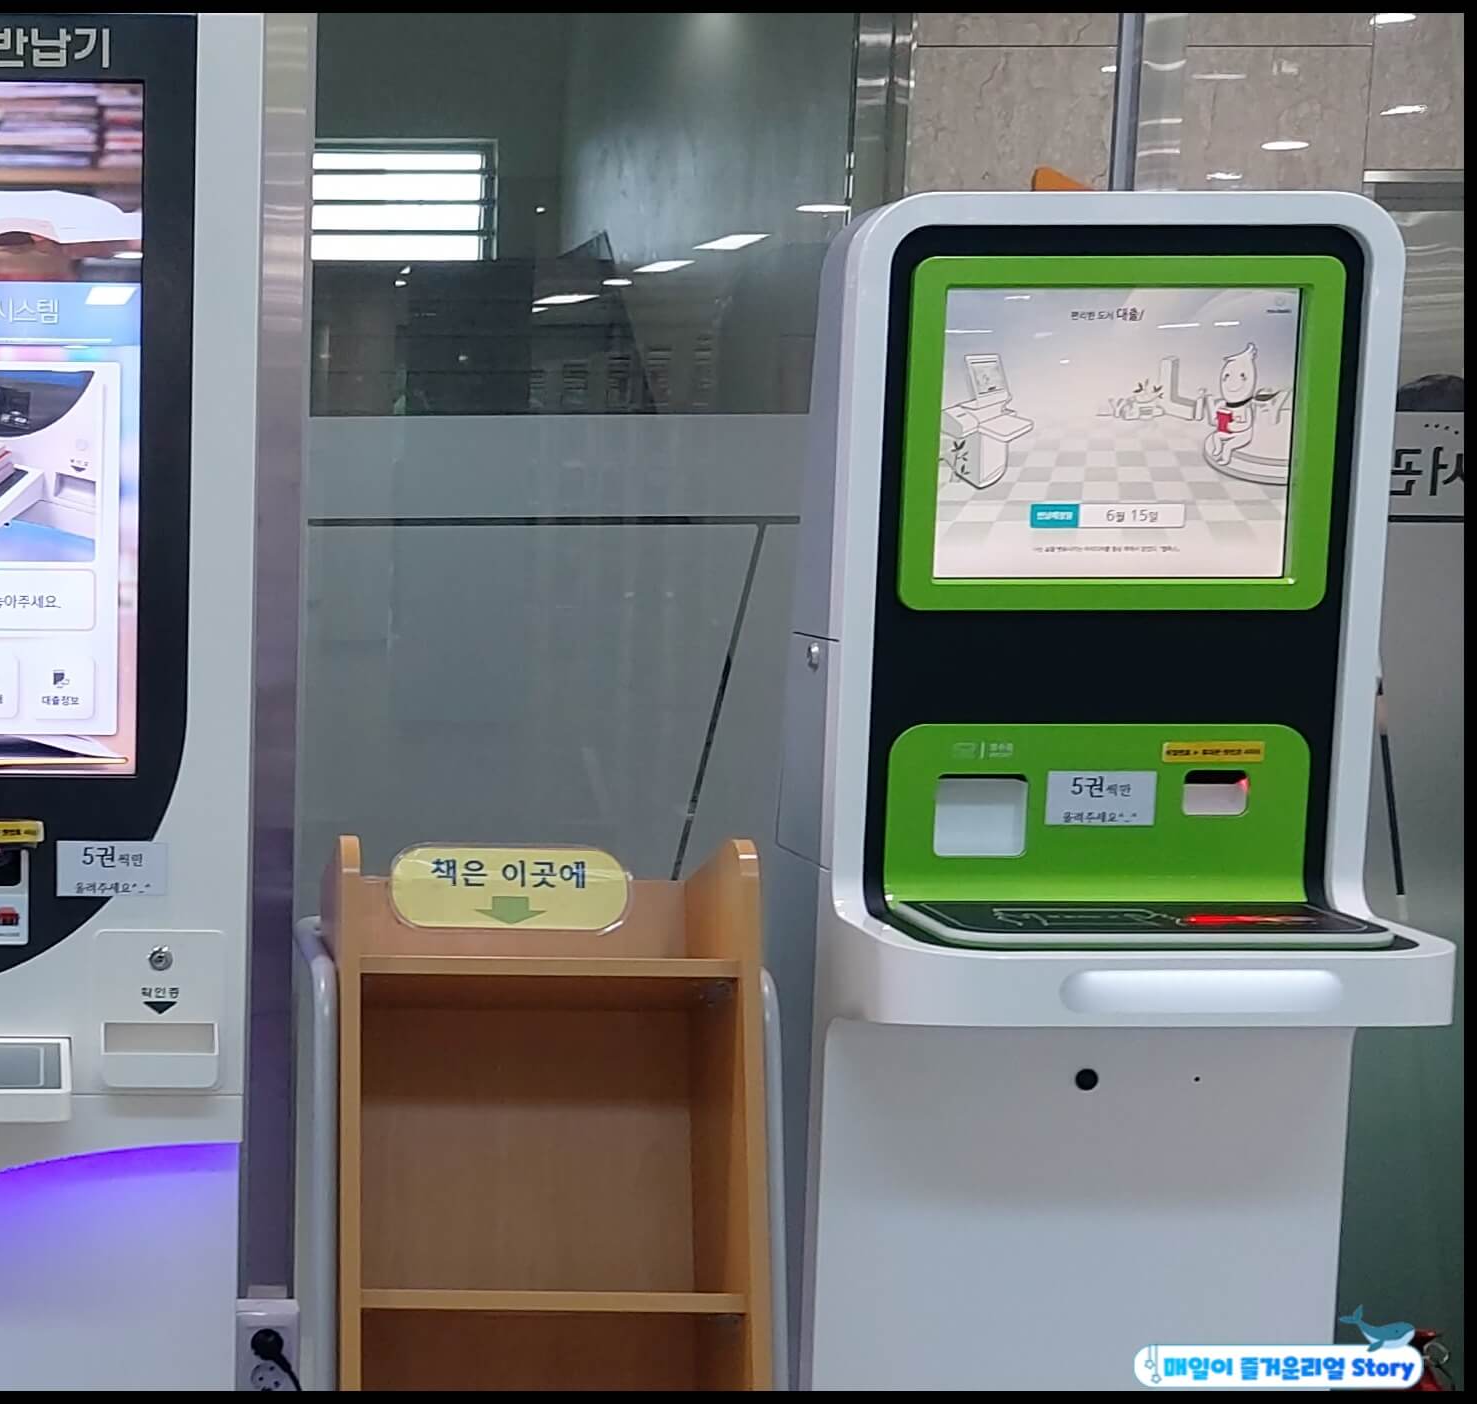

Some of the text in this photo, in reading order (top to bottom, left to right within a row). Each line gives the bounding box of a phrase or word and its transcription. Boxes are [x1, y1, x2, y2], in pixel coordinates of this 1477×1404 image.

[42, 696, 79, 706] 대출정보
[431, 858, 587, 889] 책은 이곳에
[141, 987, 179, 999] 확인증
